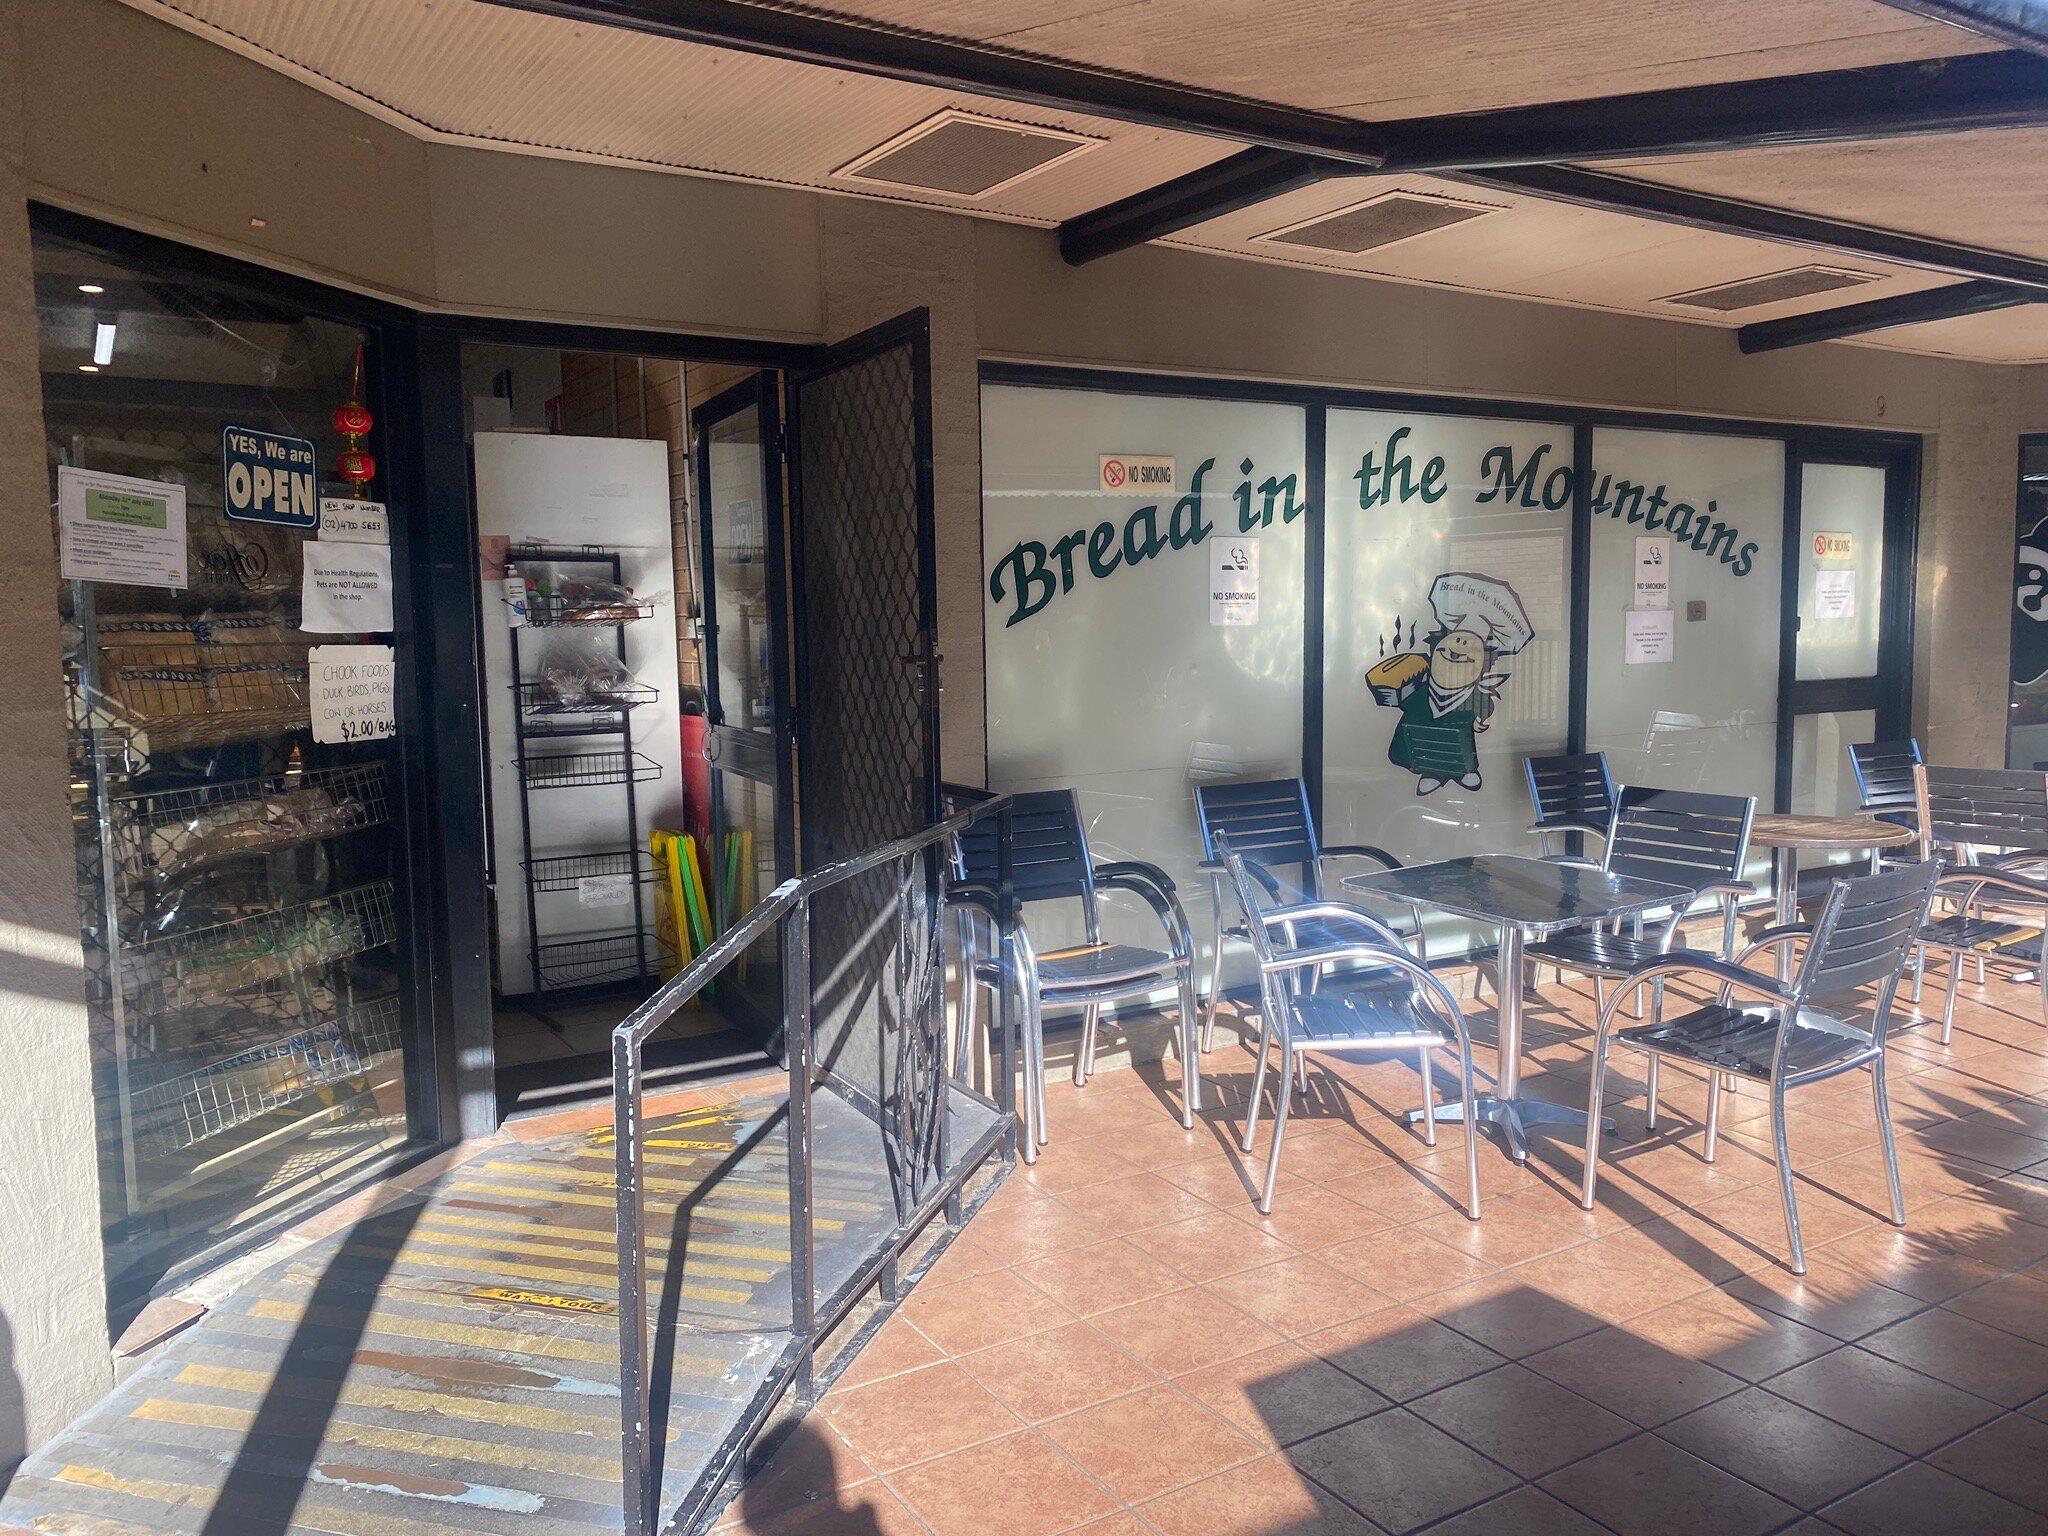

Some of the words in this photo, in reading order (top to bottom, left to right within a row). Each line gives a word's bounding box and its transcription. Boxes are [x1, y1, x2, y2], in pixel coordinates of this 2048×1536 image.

[229, 433, 261, 460] YES,
[264, 440, 286, 460] We
[289, 448, 312, 464] are
[1128, 465, 1139, 483] NO
[1141, 465, 1171, 483] SMOKING
[228, 461, 314, 517] OPEN
[324, 501, 339, 510] NEW
[342, 502, 356, 511] SHOP
[989, 456, 1217, 629] Bread
[1231, 456, 1306, 534] in
[1352, 426, 1448, 511] the
[1474, 443, 1761, 579] Mountains
[313, 568, 324, 576] Due
[331, 569, 349, 577] Health
[316, 580, 328, 588] Pets
[338, 581, 351, 589] NOT
[1636, 582, 1645, 590] NO
[1645, 582, 1667, 590] SMOKING
[1213, 592, 1224, 600] NO
[1224, 592, 1256, 600] SMOKING
[1440, 581, 1465, 592] Bread
[1467, 585, 1476, 596] in
[1477, 589, 1490, 602] the
[1491, 597, 1526, 636] Mountains
[323, 665, 358, 681] CHOOK
[361, 664, 390, 678] FOODS
[323, 707, 342, 720] COW
[344, 705, 356, 718] OR
[357, 701, 387, 716] HORSES
[559, 1299, 601, 1310] YOUR
